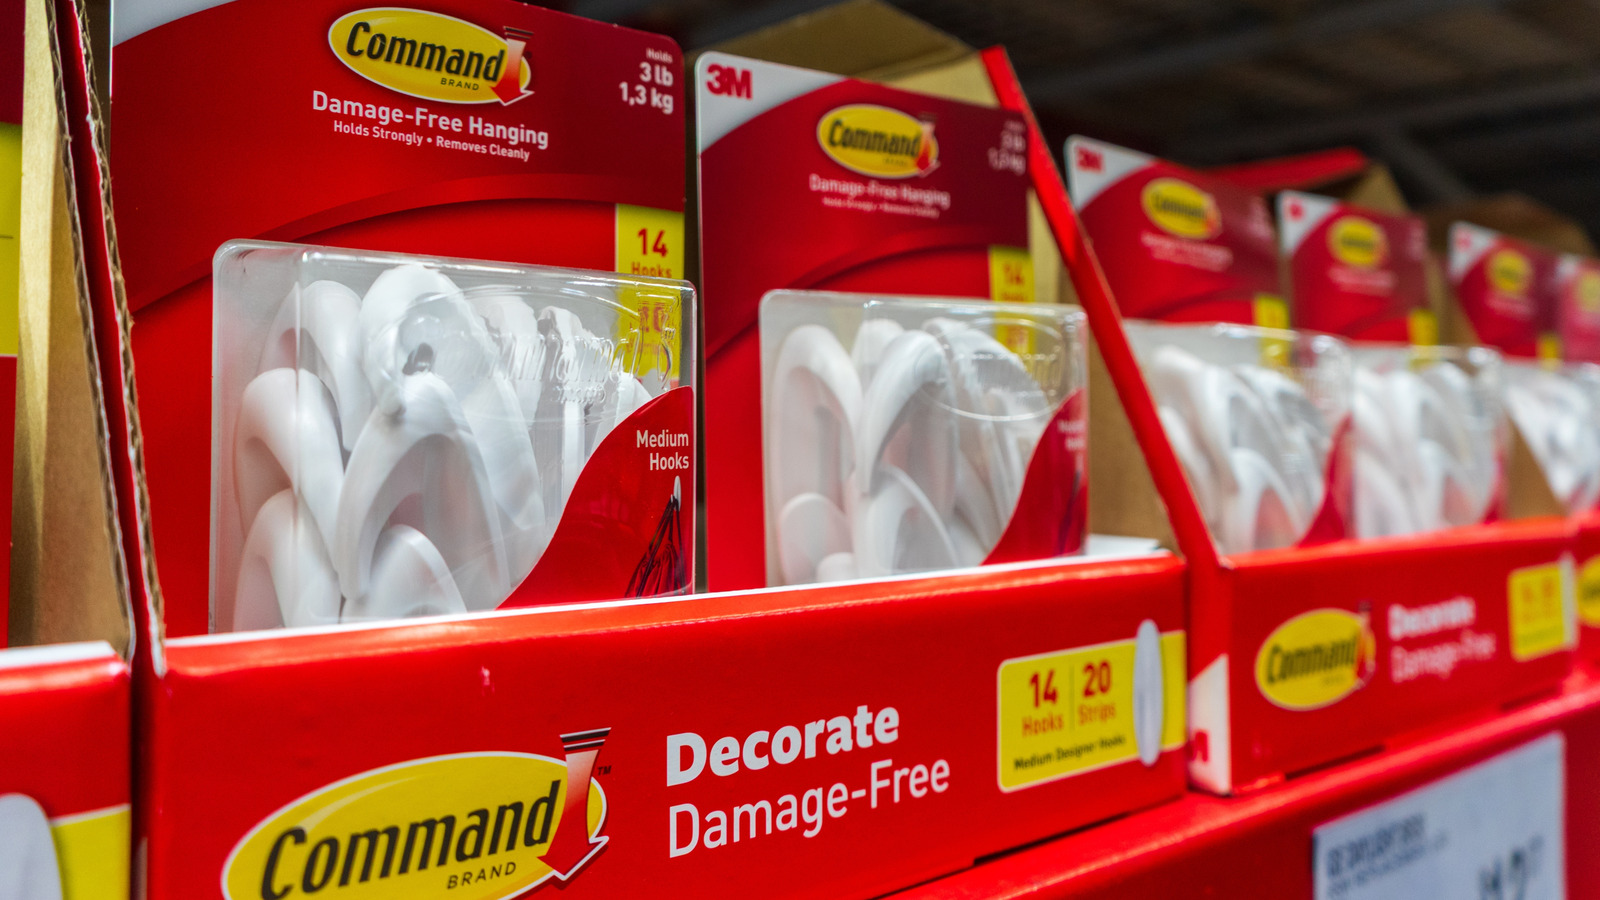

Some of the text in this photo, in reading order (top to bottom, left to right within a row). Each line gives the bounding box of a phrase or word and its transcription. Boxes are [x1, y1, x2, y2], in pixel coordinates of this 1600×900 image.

[346, 21, 505, 82] Command
[646, 48, 673, 64] Holds
[440, 77, 480, 91] BRAND
[639, 61, 674, 87] 3 lb
[706, 63, 753, 101] 3M
[619, 81, 674, 115] 1,3 kg
[312, 90, 549, 150] Damage-Free Hanging
[828, 118, 921, 159] Command
[333, 120, 530, 162] Holds Strongly Removes Cleanly
[637, 228, 669, 258] 14
[636, 429, 689, 448] Medium
[649, 452, 690, 471] Hooks
[1029, 659, 1112, 709] 14 20
[1022, 702, 1117, 738] Hooks Strips
[666, 704, 900, 788] Decorate
[669, 758, 951, 859] Damage-Free
[261, 779, 563, 900] Command
[446, 860, 517, 890] BRAND
